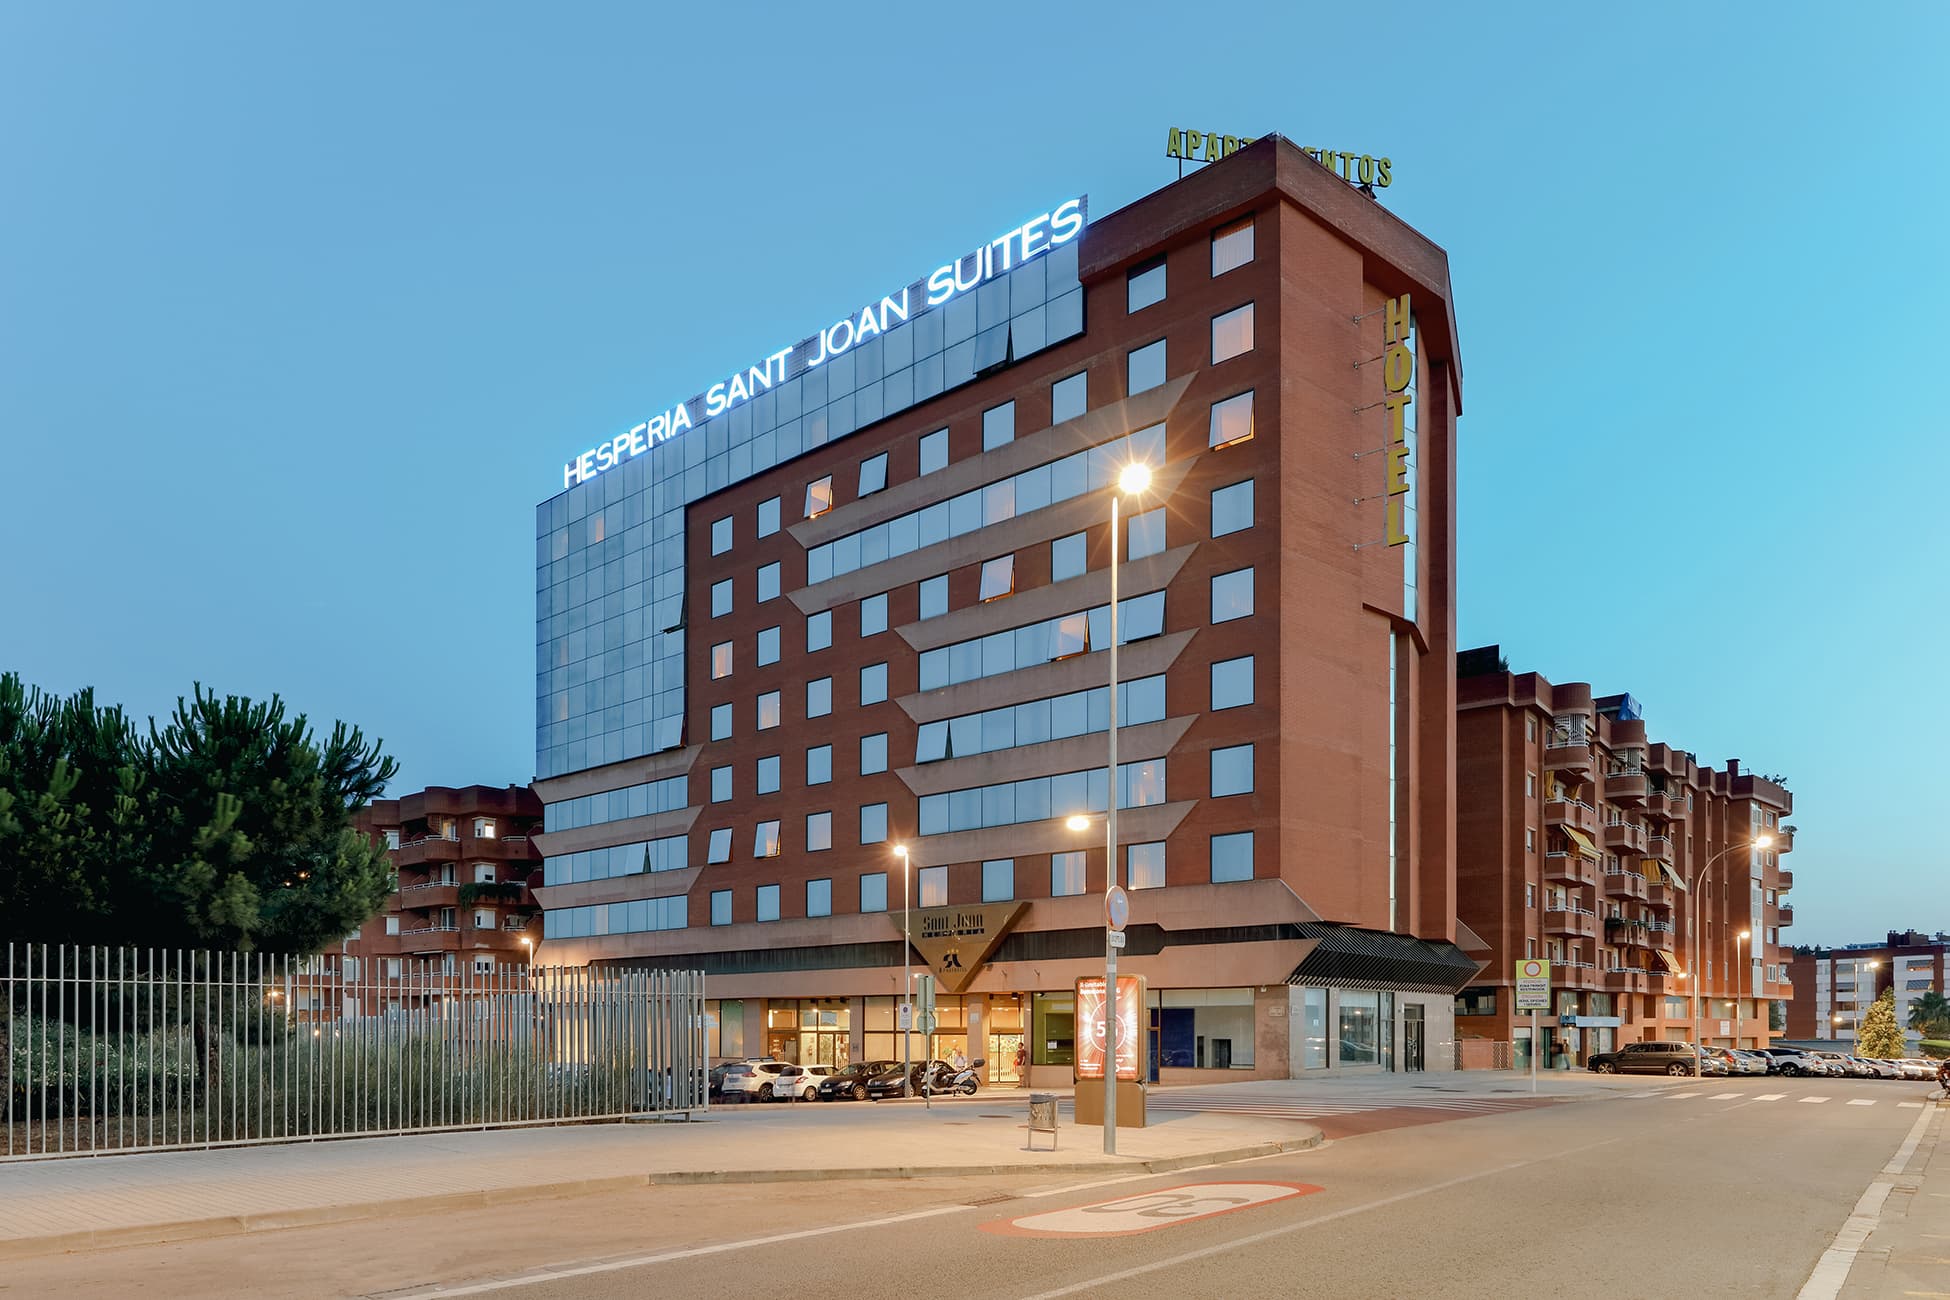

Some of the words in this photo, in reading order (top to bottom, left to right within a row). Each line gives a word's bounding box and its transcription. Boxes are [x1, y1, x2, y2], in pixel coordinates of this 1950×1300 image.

[1166, 127, 1392, 187] APARNTOS
[563, 402, 692, 489] HESPERIA
[705, 347, 793, 417] SANT
[808, 288, 908, 367] JOAN
[927, 198, 1084, 306] SUITES
[1385, 293, 1412, 547] HOTEL
